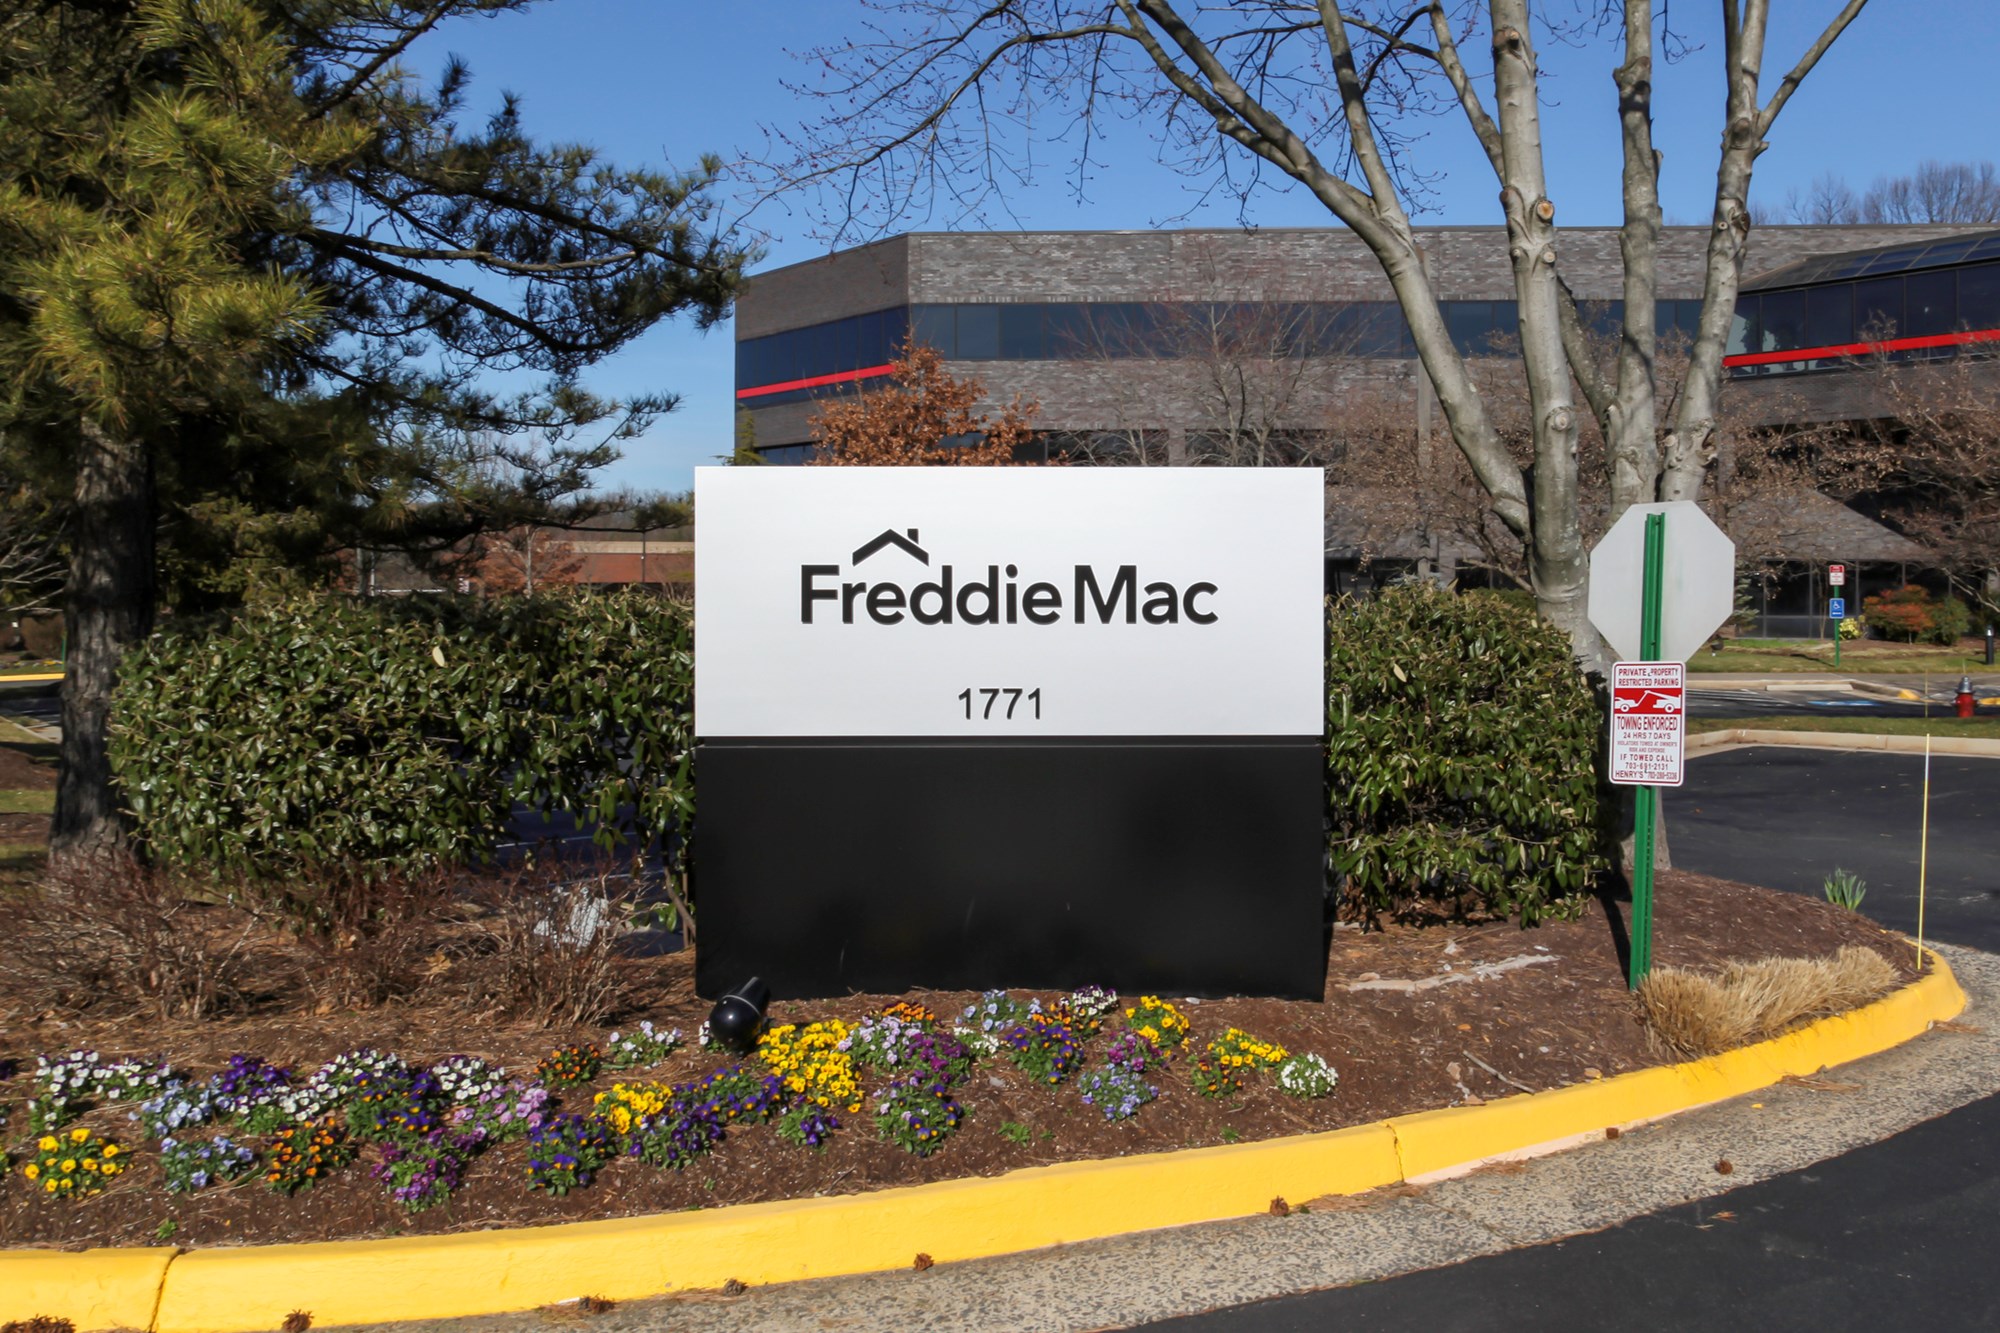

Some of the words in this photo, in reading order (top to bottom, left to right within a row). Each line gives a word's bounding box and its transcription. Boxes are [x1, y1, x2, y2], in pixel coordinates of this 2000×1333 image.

[800, 563, 1063, 626] Freddie
[1074, 564, 1220, 626] Mac
[1618, 668, 1647, 676] PRIVATE
[1650, 667, 1679, 676] PROPERTY
[1618, 678, 1652, 687] RESTRICTED
[1654, 678, 1680, 687] PARKING
[958, 687, 1042, 721] 1771
[1617, 715, 1642, 730] TOWING
[1643, 716, 1678, 731] ENFORCED
[1653, 732, 1671, 740] DAYS
[1620, 753, 1628, 761] IF
[1629, 754, 1653, 762] TOWED
[1655, 754, 1674, 762] CALL
[1625, 762, 1668, 770] 703-691-2131
[1616, 770, 1644, 778] HENRY'S
